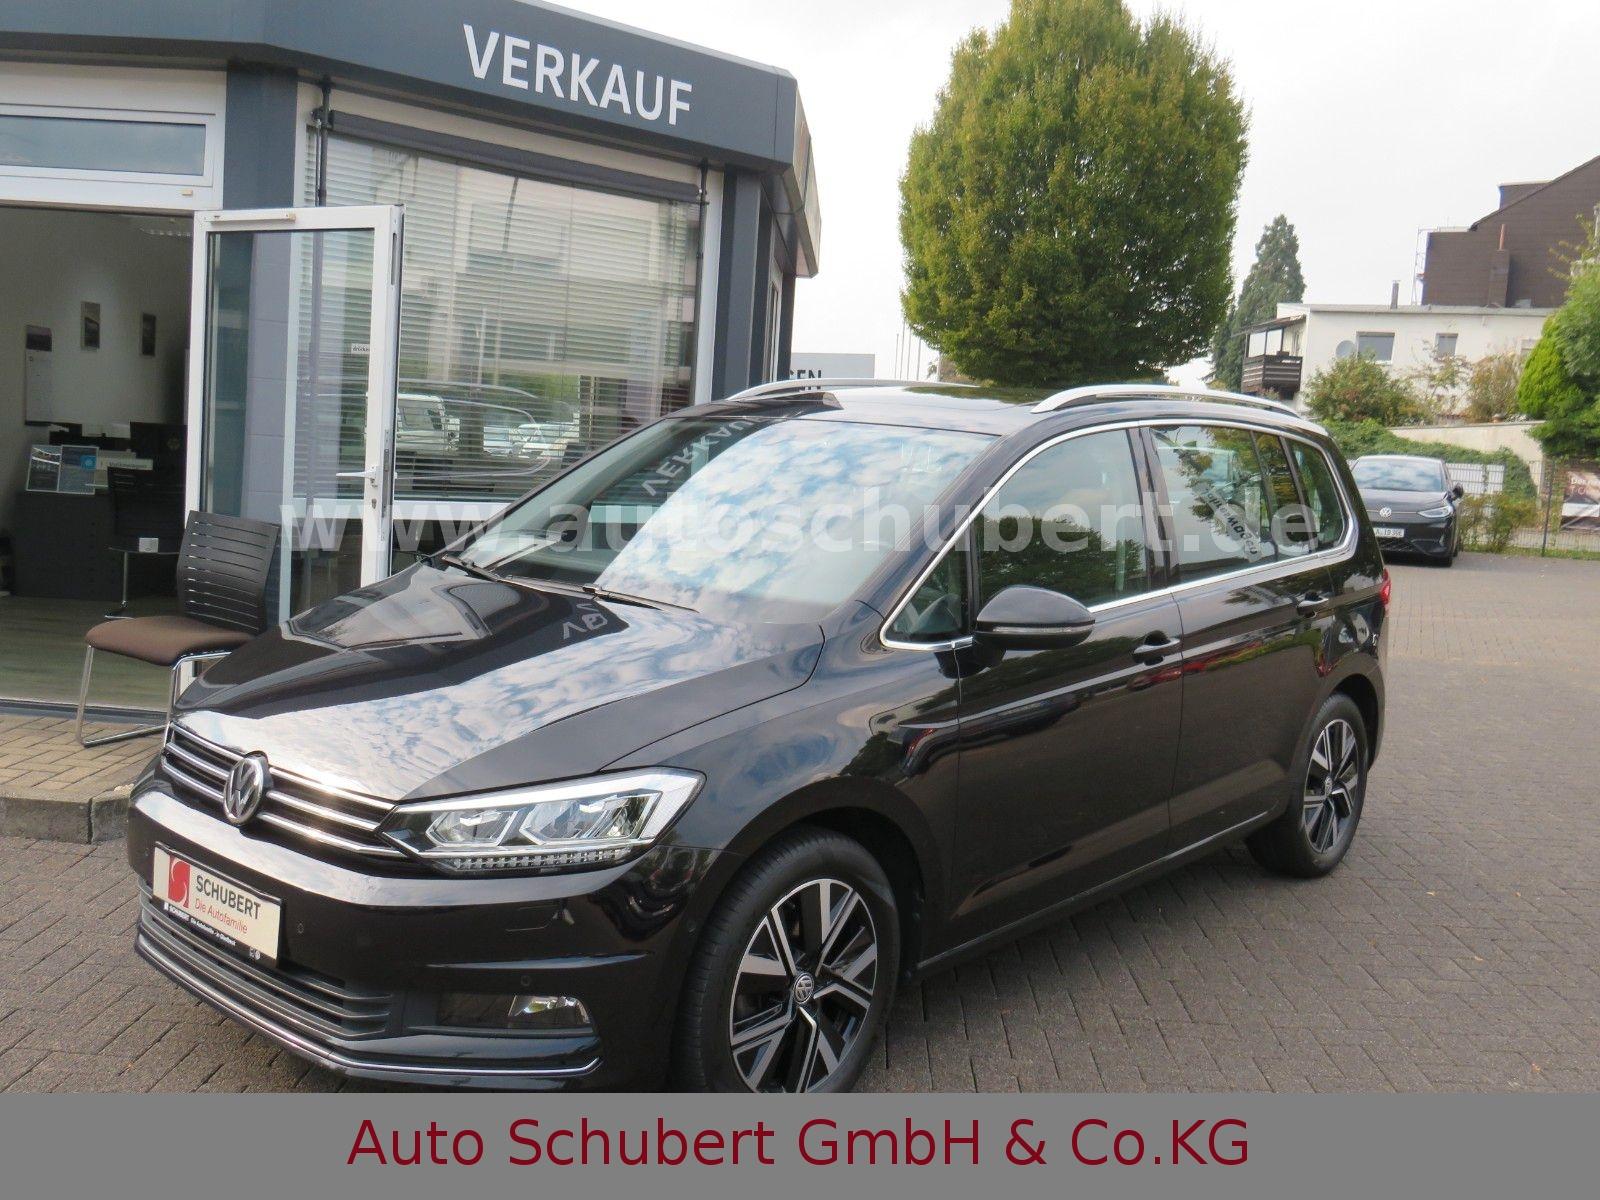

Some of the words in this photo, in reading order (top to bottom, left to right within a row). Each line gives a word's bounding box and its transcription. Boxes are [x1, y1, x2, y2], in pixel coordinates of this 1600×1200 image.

[463, 24, 693, 126] VERKAUF
[195, 898, 207, 913] Die
[208, 905, 248, 934] Autofamilie
[196, 874, 261, 920] SCHUBERT
